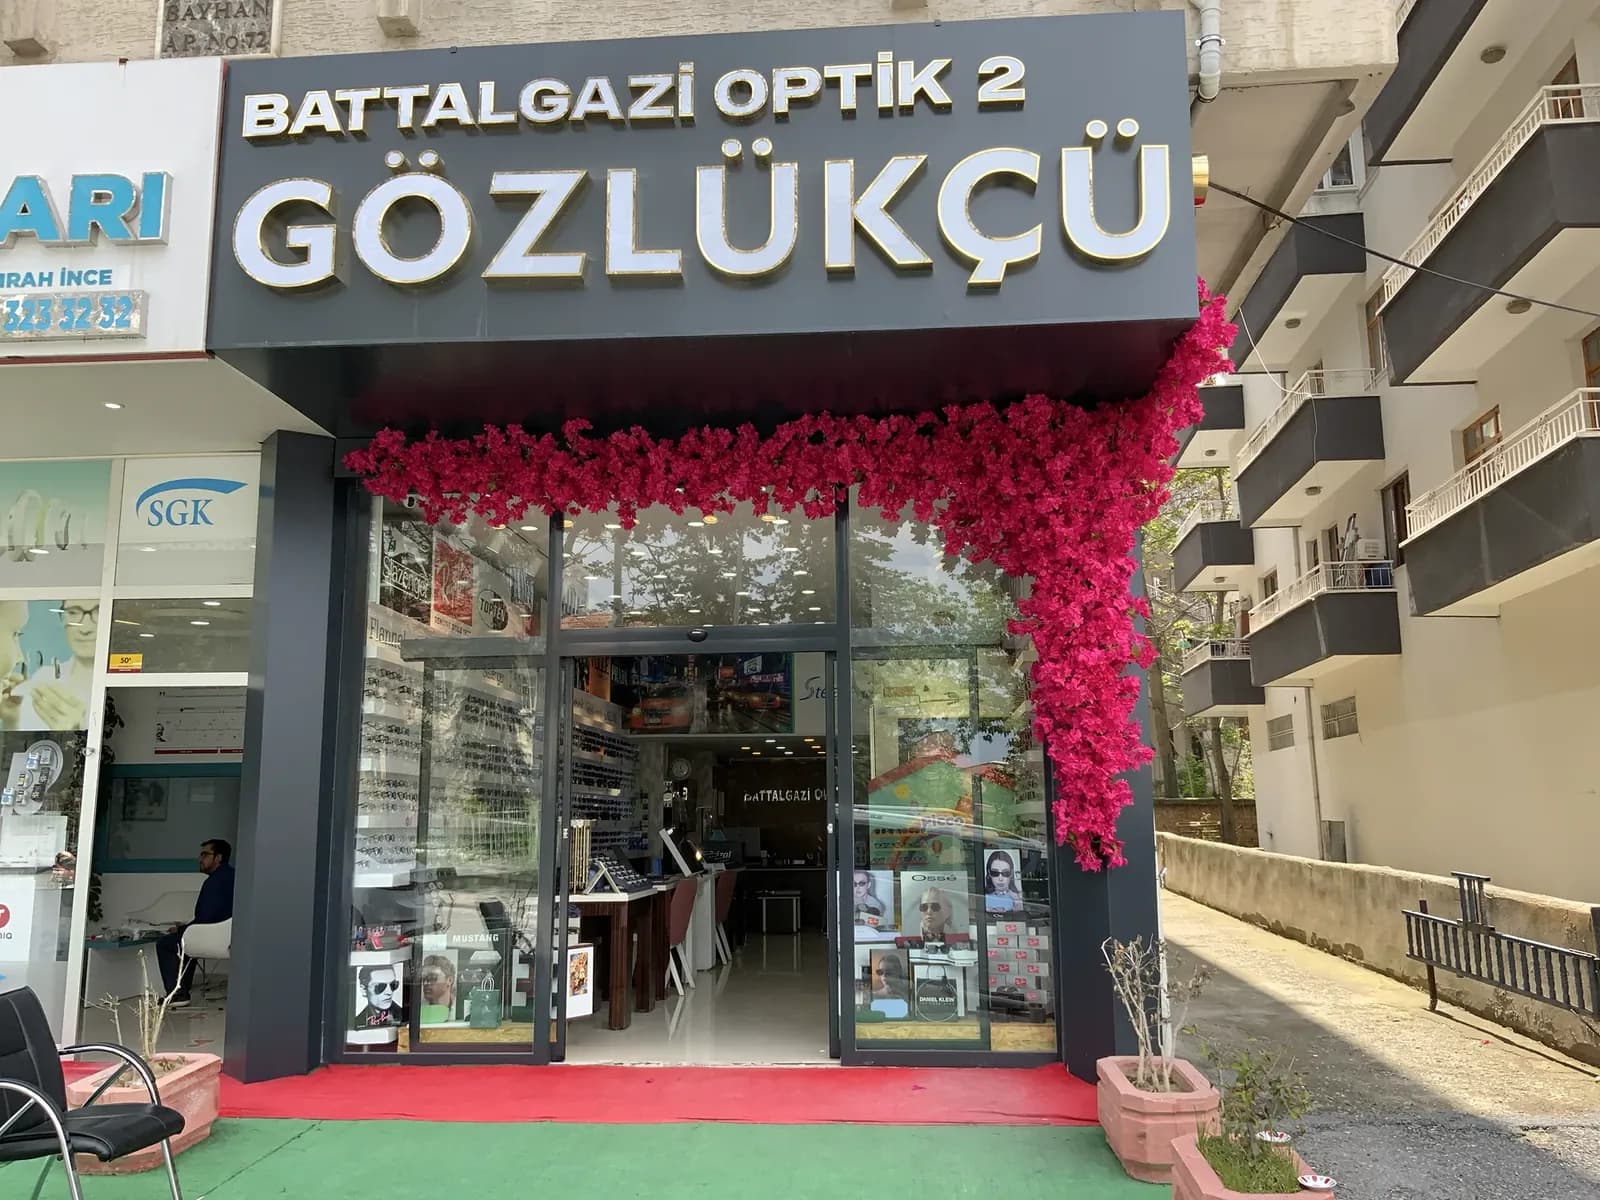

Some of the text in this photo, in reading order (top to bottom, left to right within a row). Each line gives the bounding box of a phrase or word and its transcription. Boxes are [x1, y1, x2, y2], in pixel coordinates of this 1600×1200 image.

[166, 0, 271, 21] BAYHAN
[242, 51, 1026, 138] BATTALGAZİ OPTİK 2
[232, 118, 1171, 288] GÖZLÜKÇÜ
[0, 267, 113, 289] RAH İNCE
[3, 295, 132, 332] 323 32 32
[147, 499, 214, 526] SGK
[0, 931, 13, 940] ia
[452, 933, 499, 944] MUSTANG
